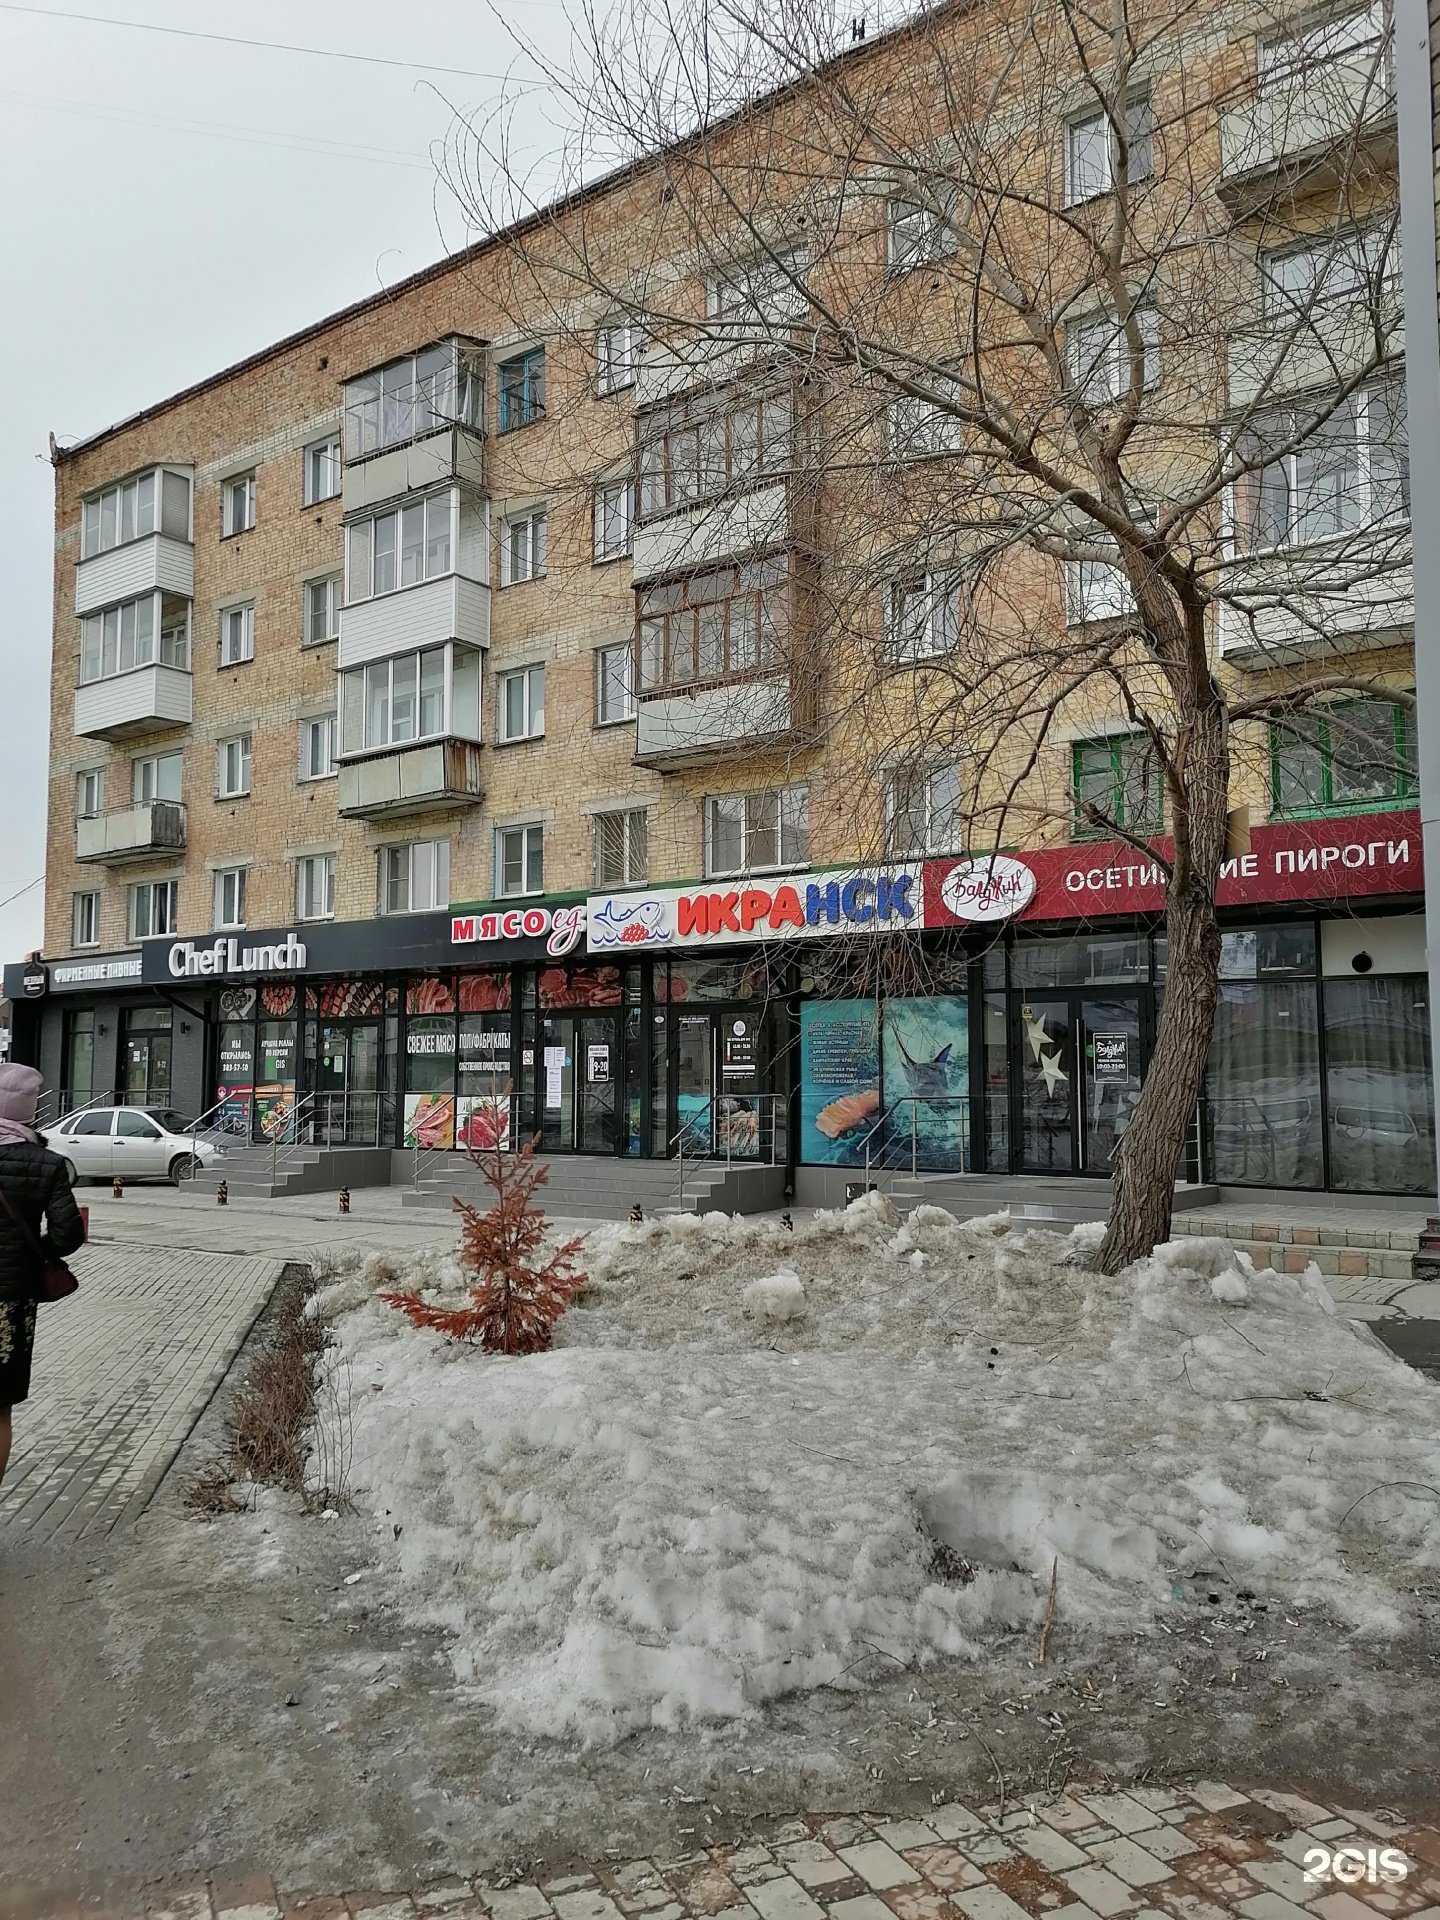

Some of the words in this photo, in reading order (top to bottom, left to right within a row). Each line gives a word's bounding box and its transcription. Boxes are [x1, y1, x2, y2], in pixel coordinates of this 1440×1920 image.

[1065, 853, 1259, 892] ОСЕТИИЕ
[1275, 839, 1409, 874] ПИРОГИ
[407, 1034, 435, 1054] СВЕЖЕЕ
